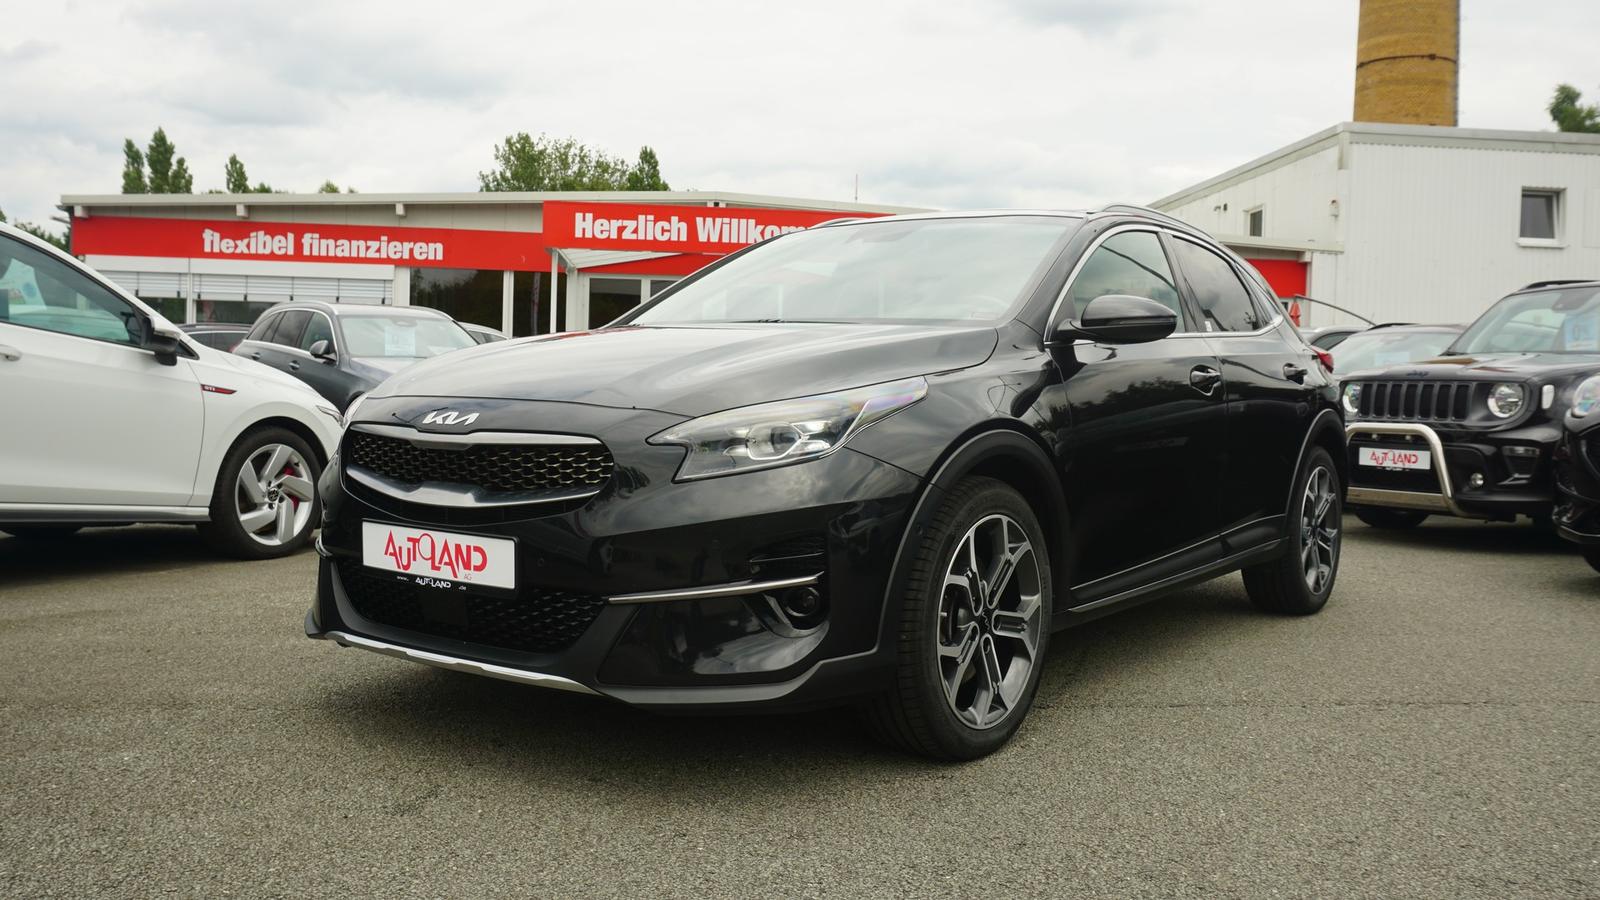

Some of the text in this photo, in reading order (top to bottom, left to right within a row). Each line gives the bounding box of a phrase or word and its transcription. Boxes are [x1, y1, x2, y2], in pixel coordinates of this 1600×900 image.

[575, 212, 806, 244] Herzlich Willko
[202, 228, 444, 261] flexibel finanzieren
